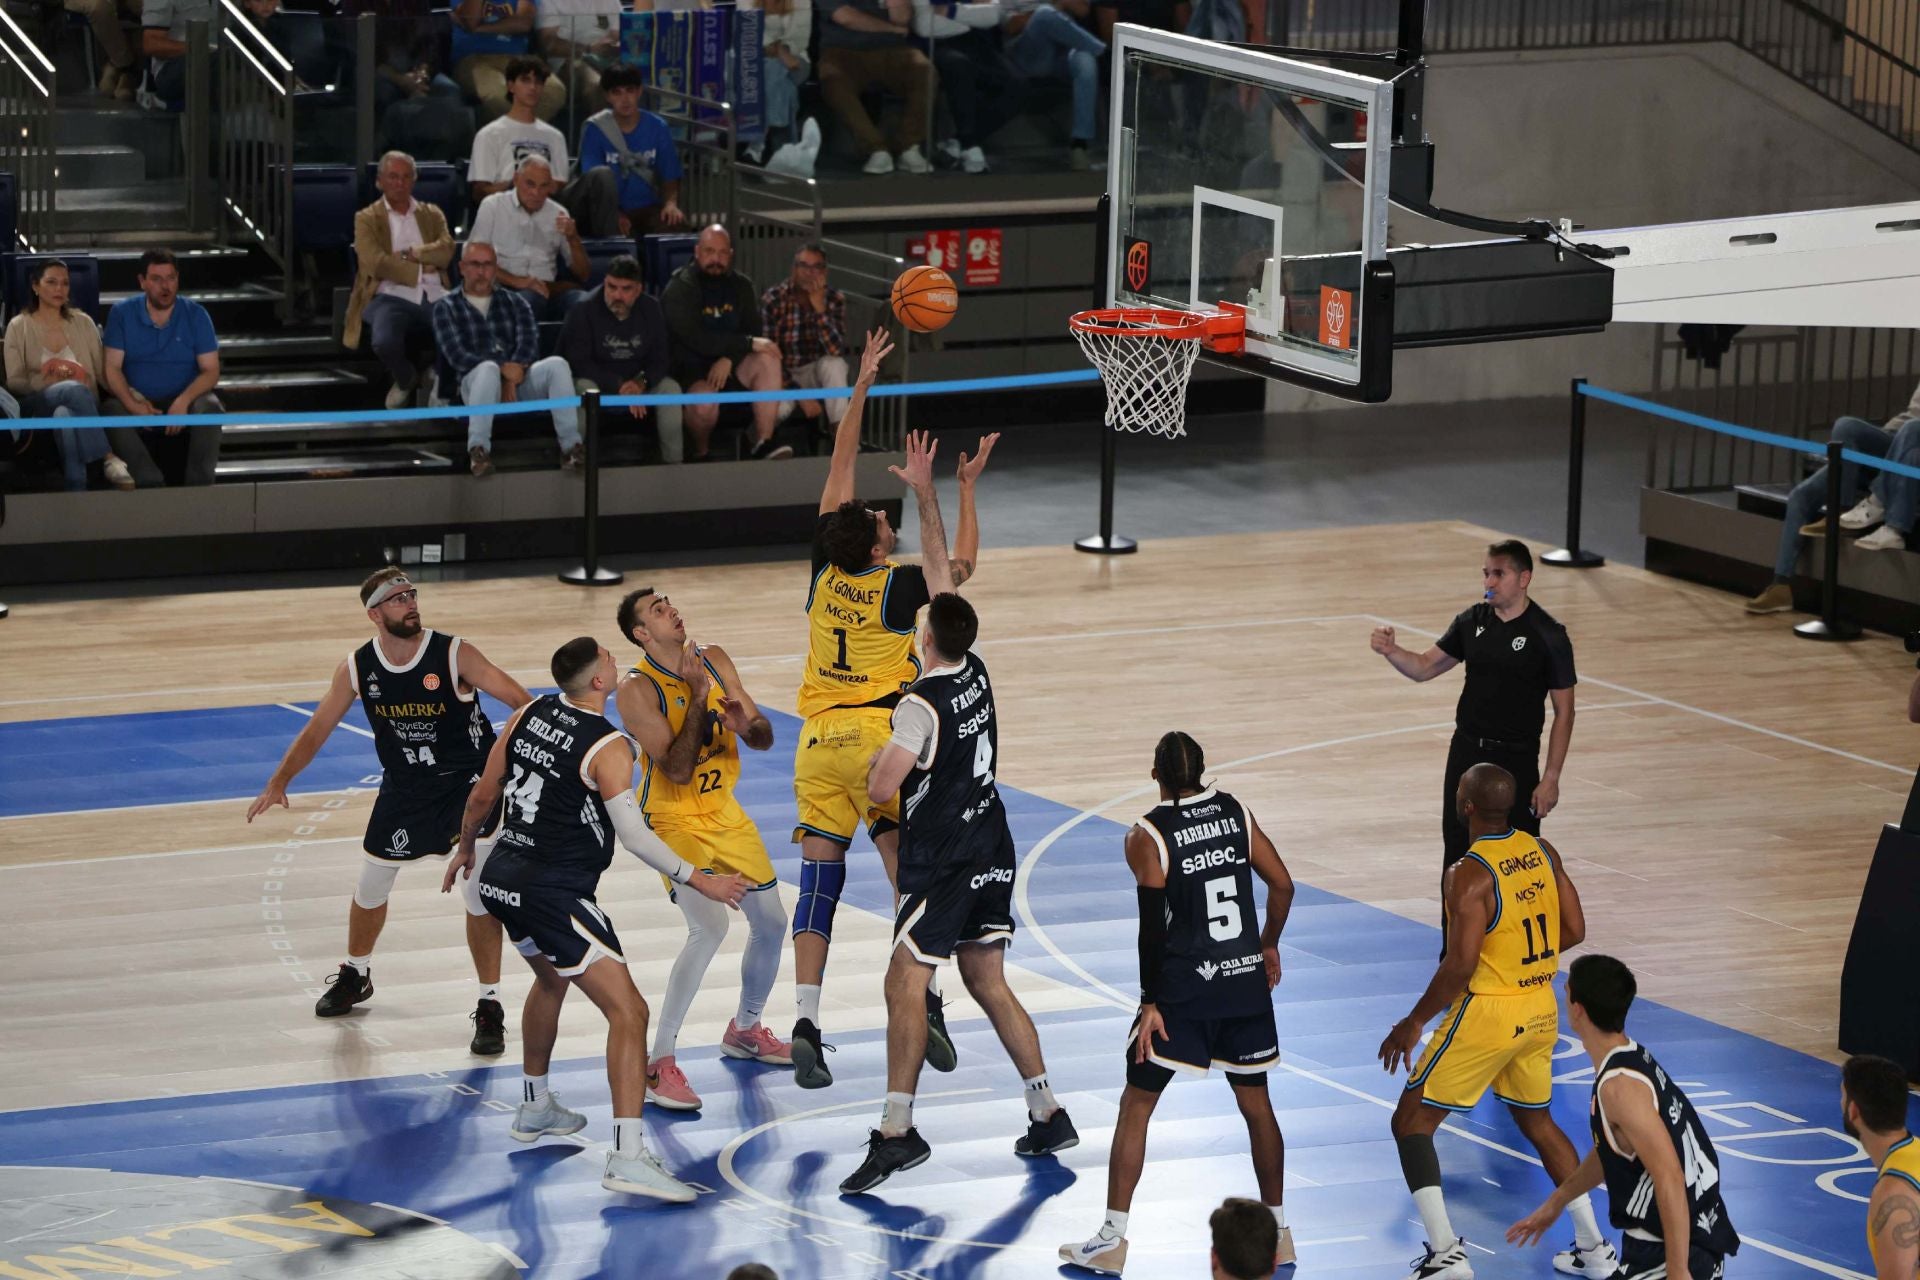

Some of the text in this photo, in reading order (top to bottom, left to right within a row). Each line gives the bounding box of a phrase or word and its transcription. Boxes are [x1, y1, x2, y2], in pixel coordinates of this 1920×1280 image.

[826, 574, 836, 590] A.
[825, 603, 855, 624] MGS
[832, 628, 852, 671] 1
[819, 668, 869, 683] telepizza
[375, 702, 446, 718] ALIMERKA
[561, 735, 574, 752] D.
[402, 746, 436, 766] 24
[973, 728, 996, 787] 4
[699, 769, 722, 794] 22
[504, 763, 544, 824] 14
[1191, 804, 1222, 816] Enerthy
[1174, 820, 1223, 848] PARHAM
[1231, 817, 1240, 834] G.
[479, 882, 521, 907] confia
[1204, 875, 1243, 942] 5
[1521, 913, 1555, 966] 11
[1220, 958, 1241, 970] CAJA
[1222, 969, 1231, 977] DE
